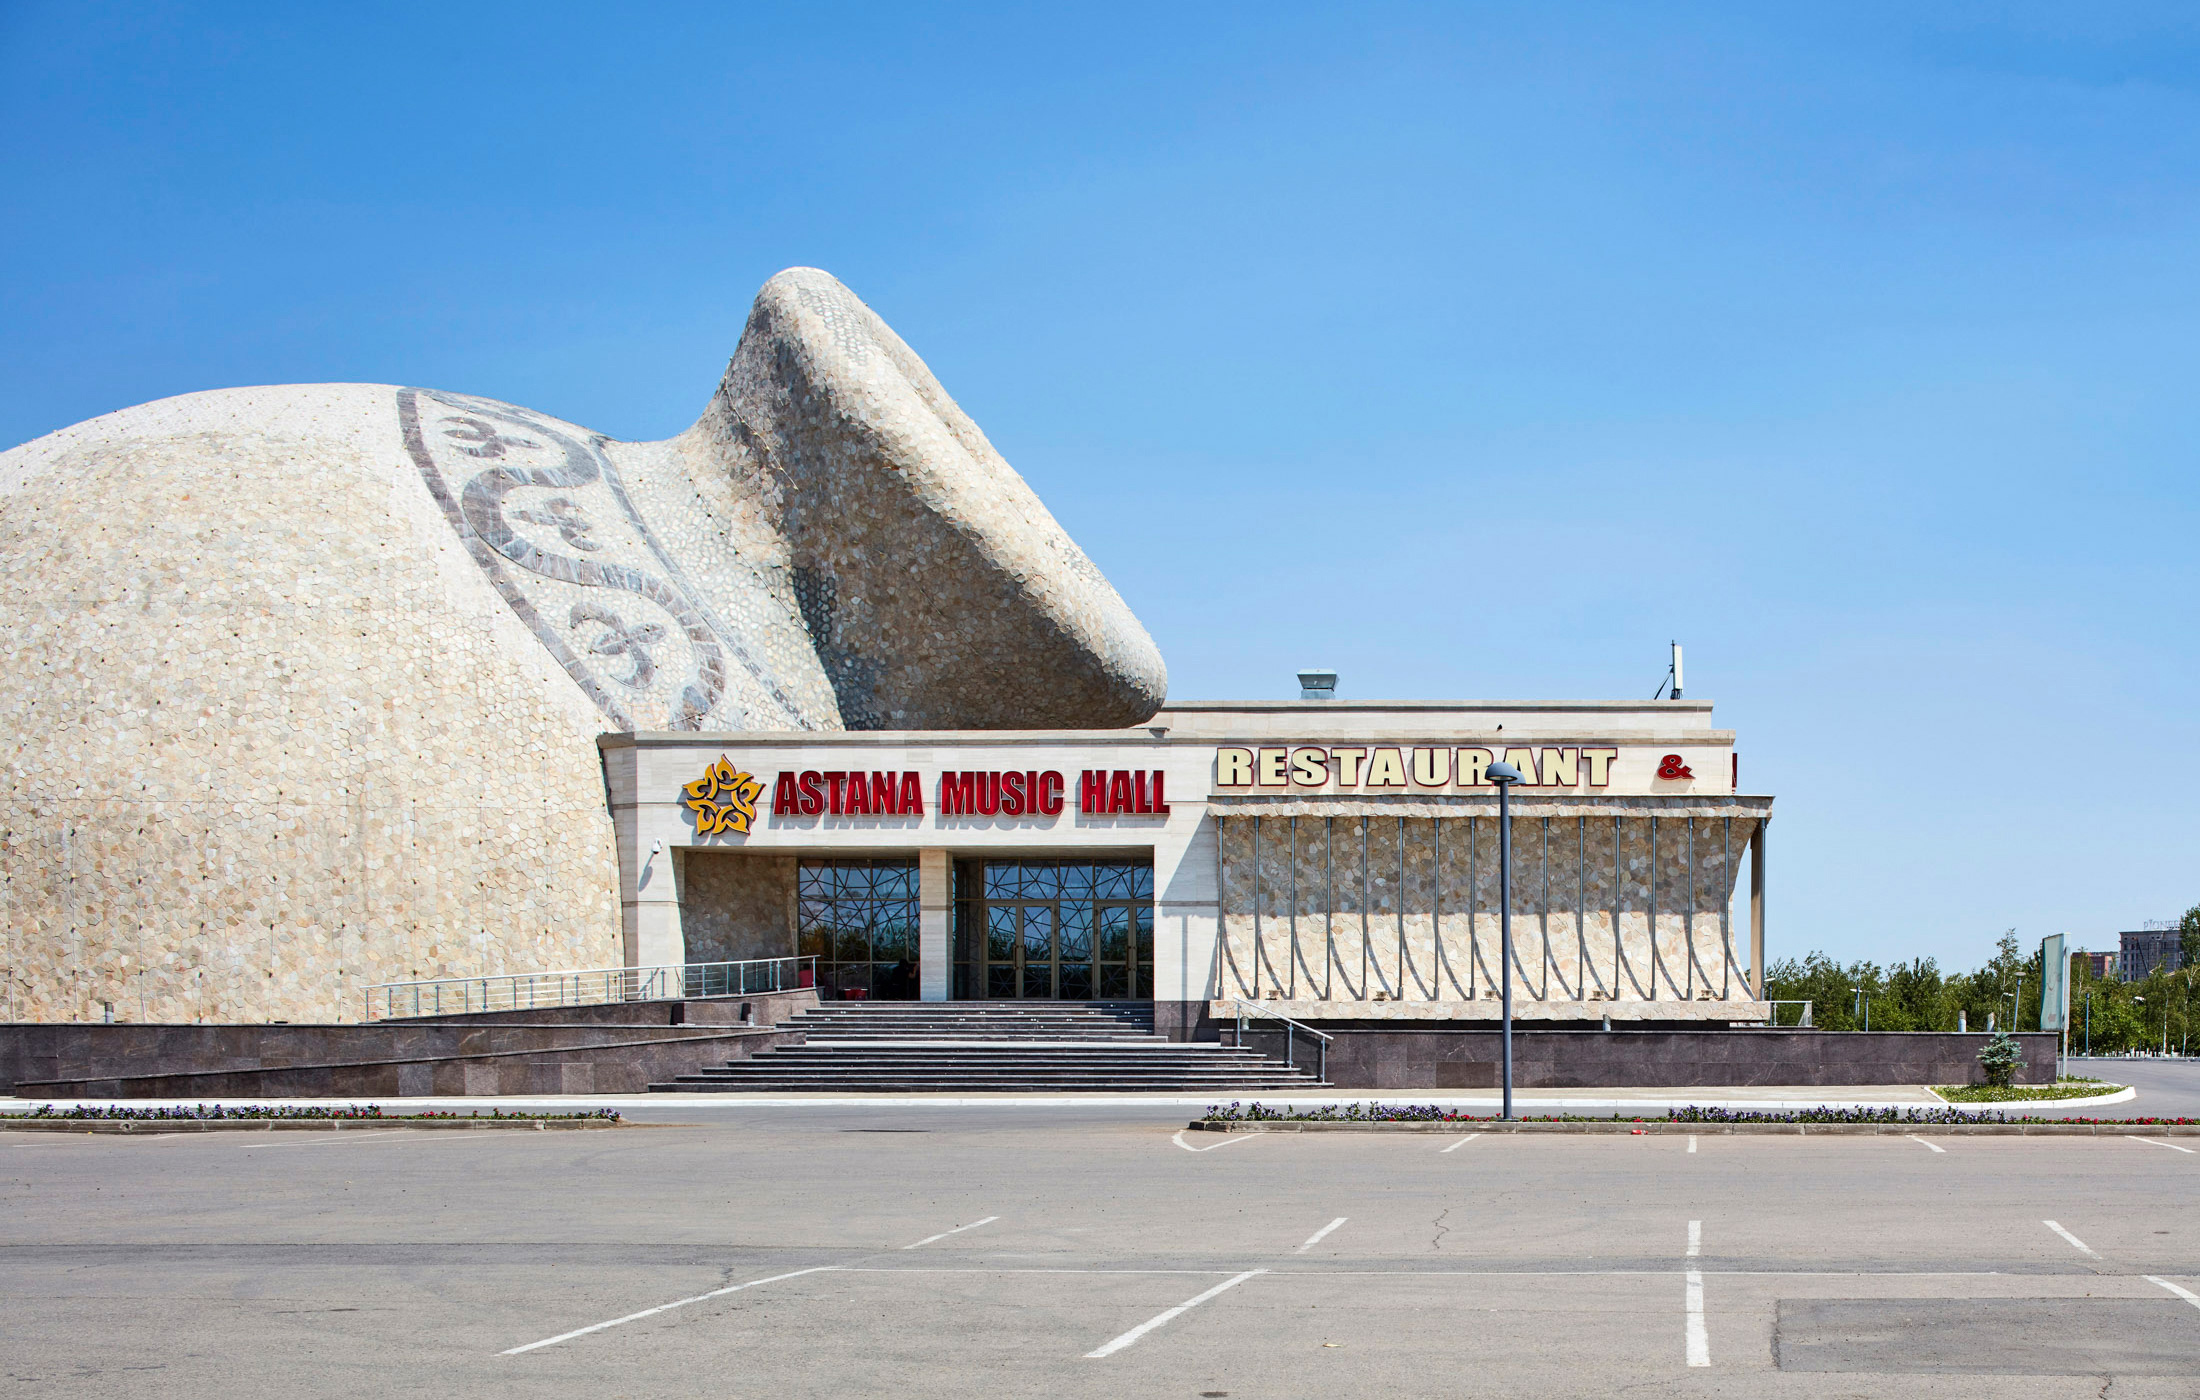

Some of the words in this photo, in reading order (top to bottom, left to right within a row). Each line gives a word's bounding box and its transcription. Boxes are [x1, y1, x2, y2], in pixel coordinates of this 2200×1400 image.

[1216, 746, 1618, 787] RESTAURANT
[1657, 754, 1696, 780] &
[774, 770, 924, 816] ASTANA
[941, 770, 1065, 816] MUSIC
[1082, 769, 1171, 815] HALL
[2143, 919, 2182, 930] PIONEE
